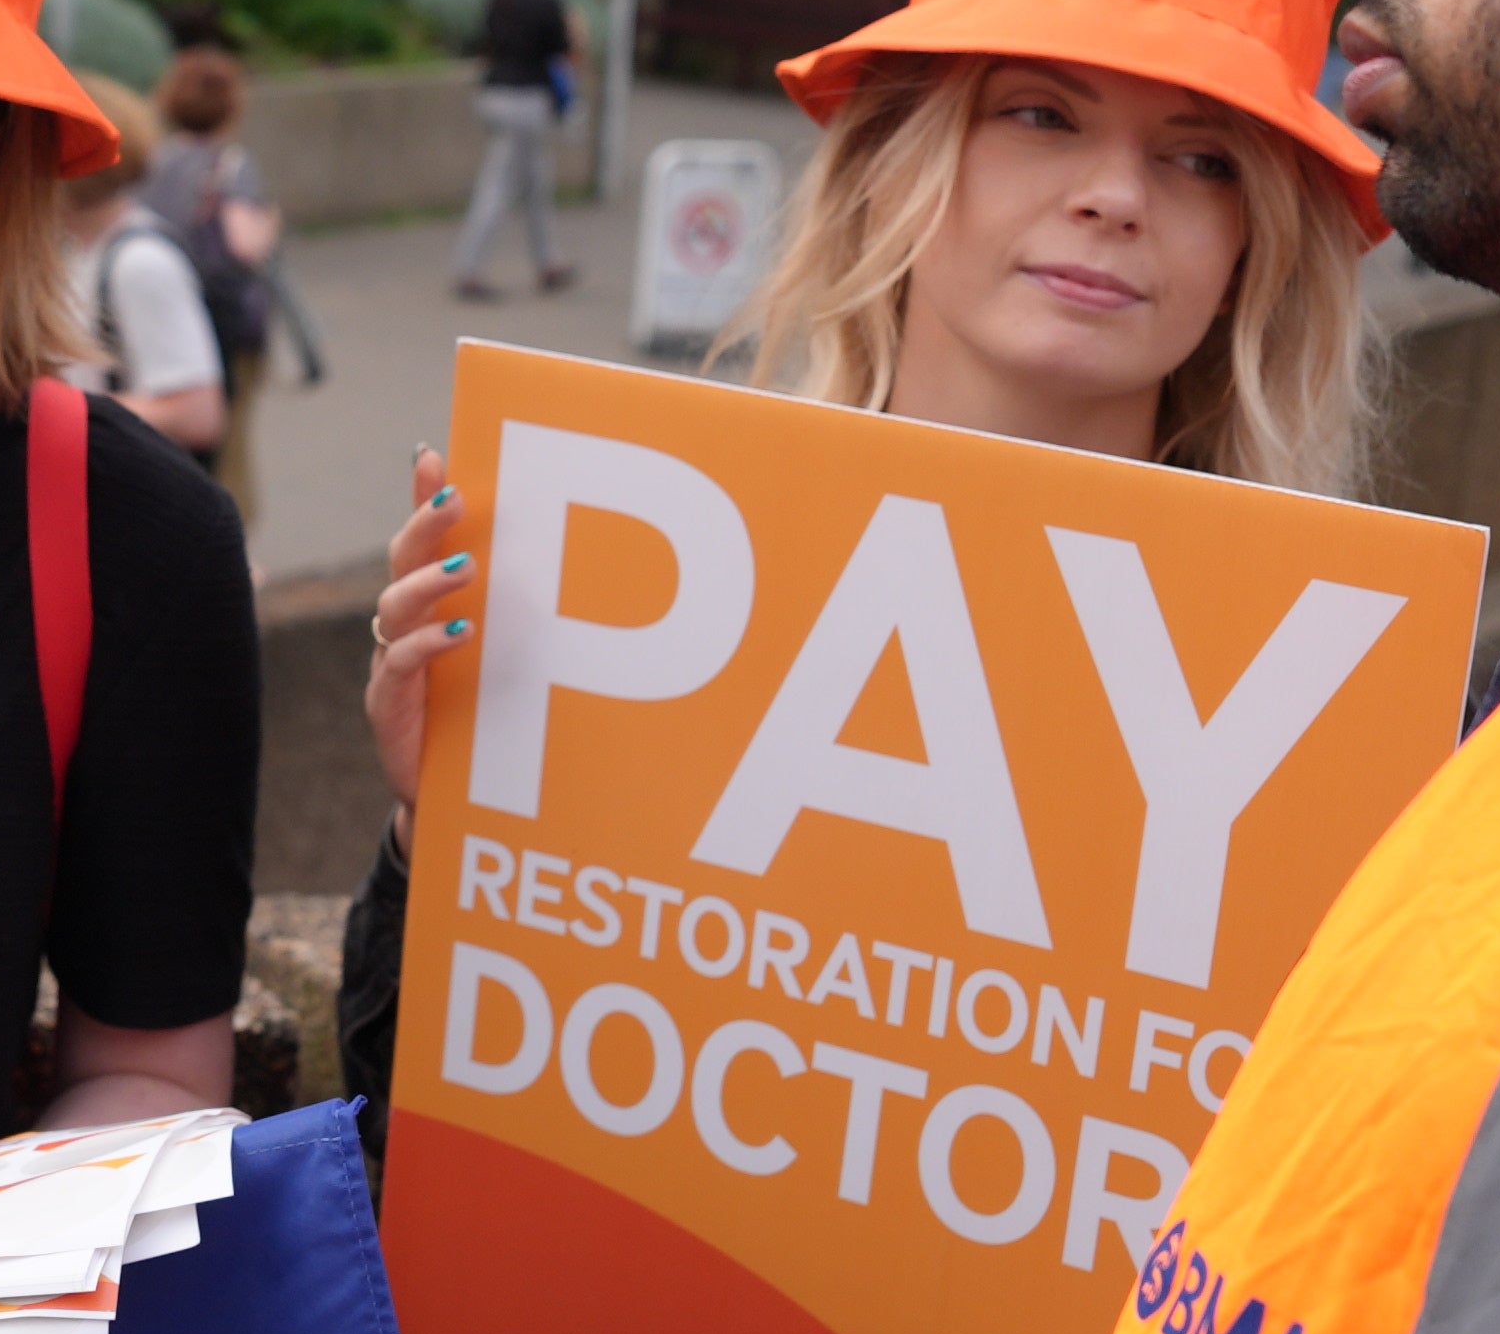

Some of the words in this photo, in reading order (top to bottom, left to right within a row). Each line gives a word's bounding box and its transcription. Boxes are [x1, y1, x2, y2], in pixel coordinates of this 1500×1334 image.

[468, 419, 1409, 991] PAY
[440, 940, 1193, 1273] DOCTOR
[457, 833, 1106, 1080] RESTORATION
[1128, 1007, 1254, 1116] FO
